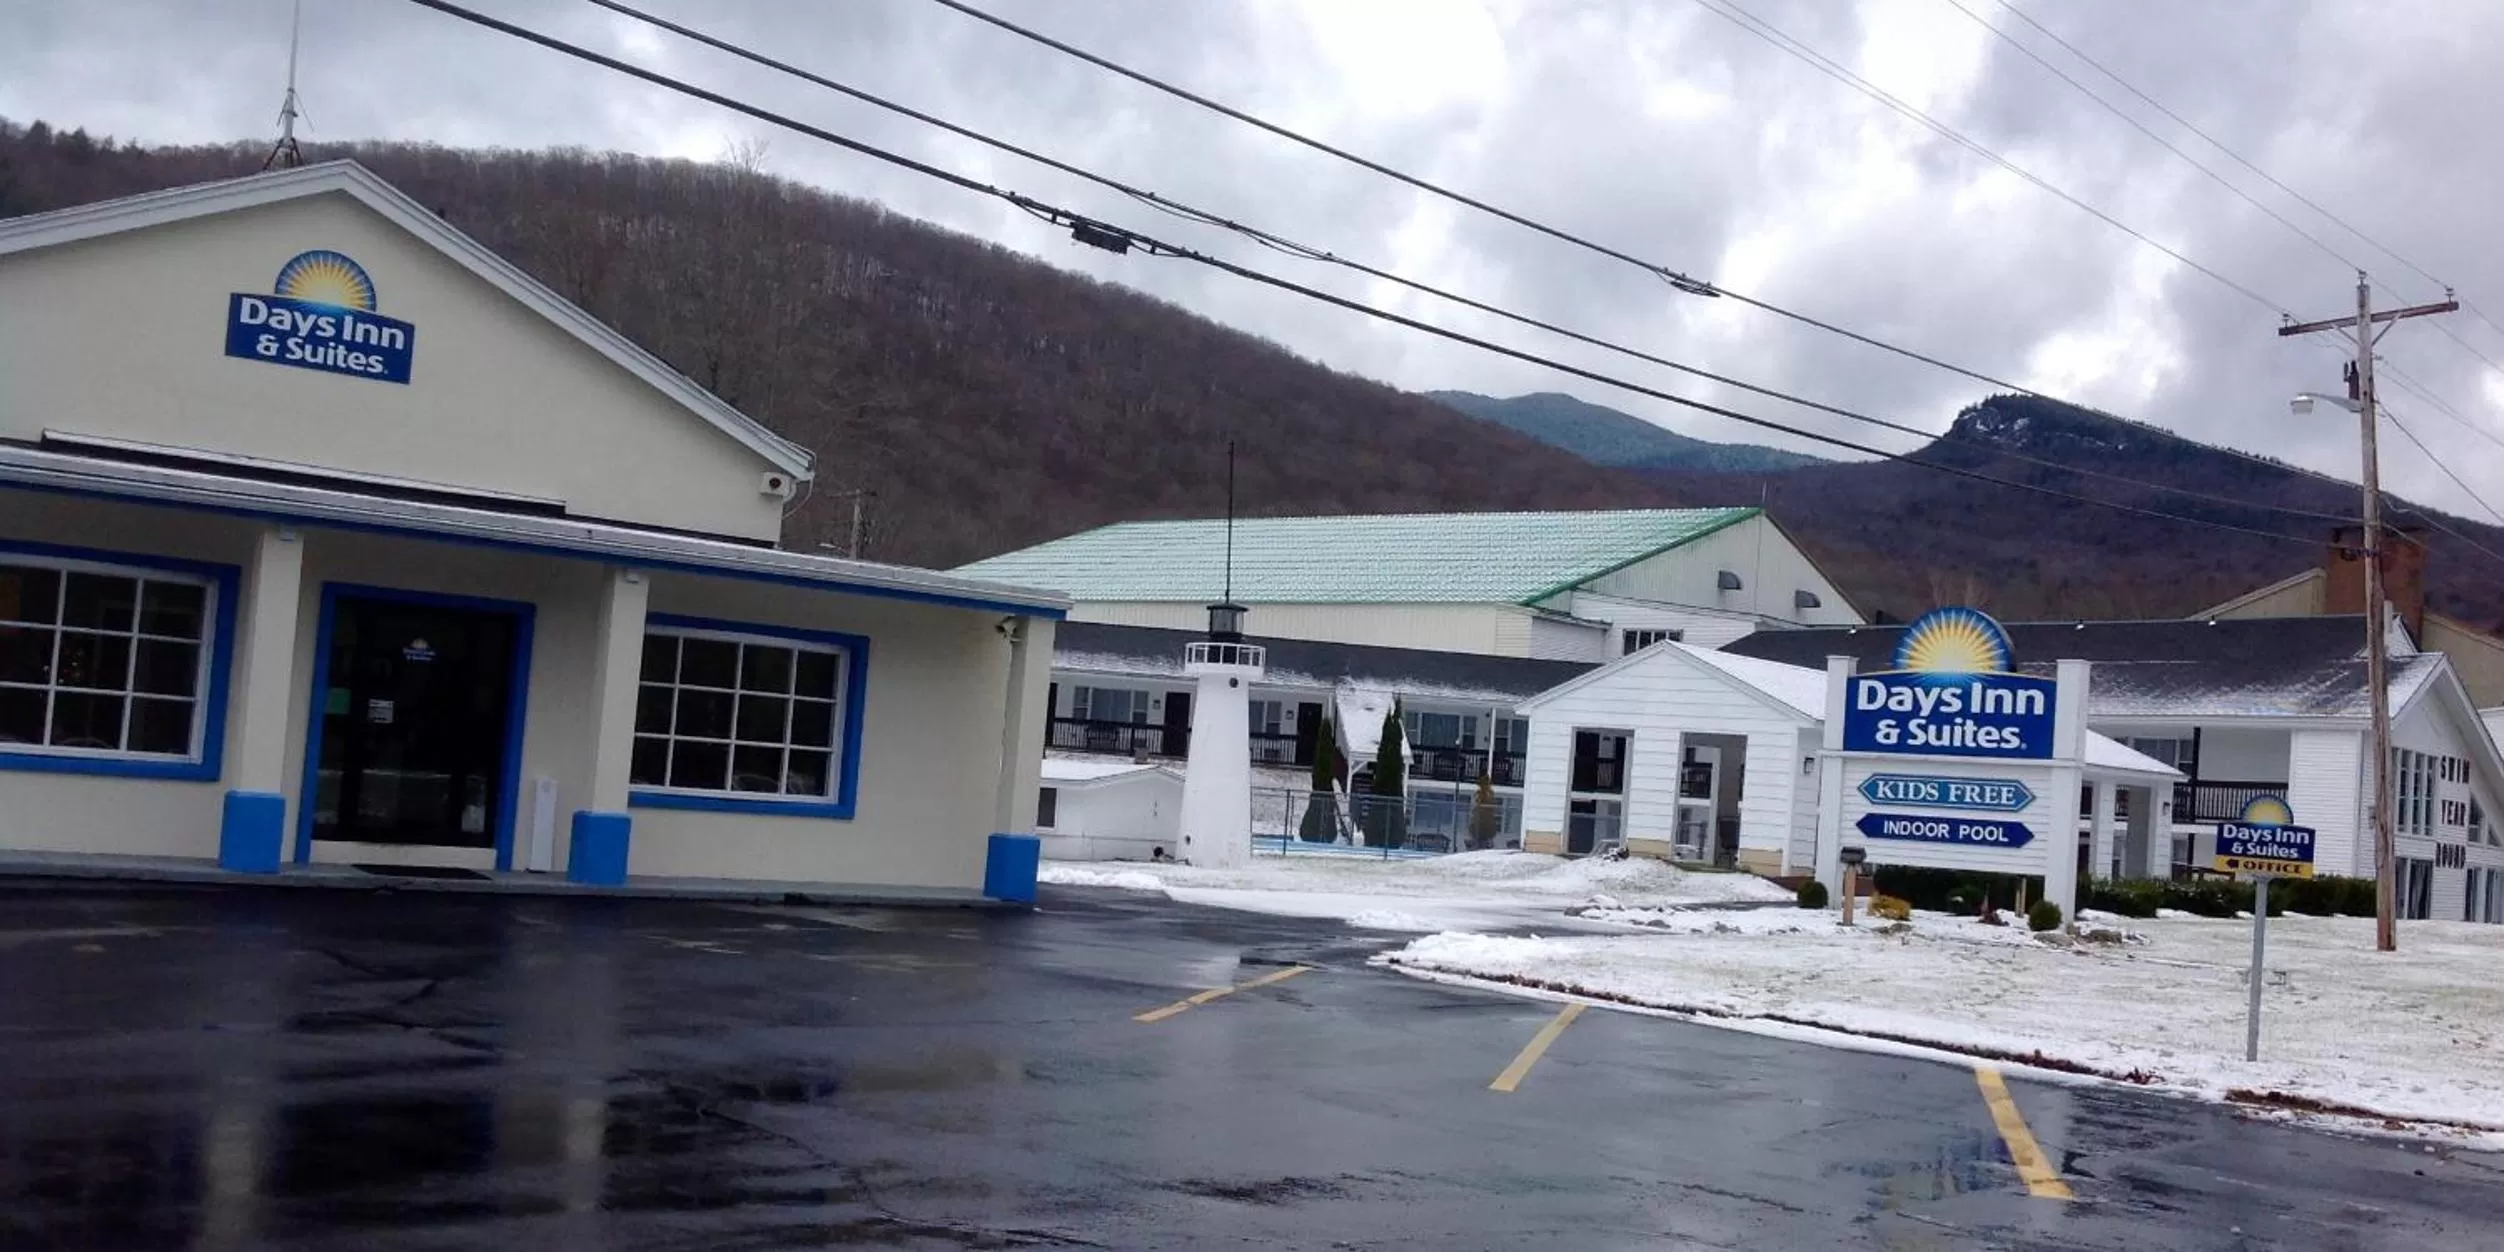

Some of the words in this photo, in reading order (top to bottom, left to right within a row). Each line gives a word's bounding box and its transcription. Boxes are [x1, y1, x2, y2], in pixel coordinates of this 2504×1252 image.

[240, 297, 336, 337] Days
[343, 315, 405, 350] Inn
[256, 333, 280, 356] &
[1857, 680, 1962, 717] Days
[1971, 682, 2045, 715] Inn
[1875, 719, 1901, 744] &
[1876, 780, 1940, 801] KIDS
[1947, 783, 2017, 805] FREE
[1883, 820, 1950, 839] INDOOR
[1959, 826, 2009, 842] POOL
[2223, 824, 2273, 842] Days
[2275, 827, 2310, 845] Inn
[2231, 841, 2244, 854] &
[2246, 842, 2299, 859] Suites
[2243, 860, 2302, 874] OFFICE
